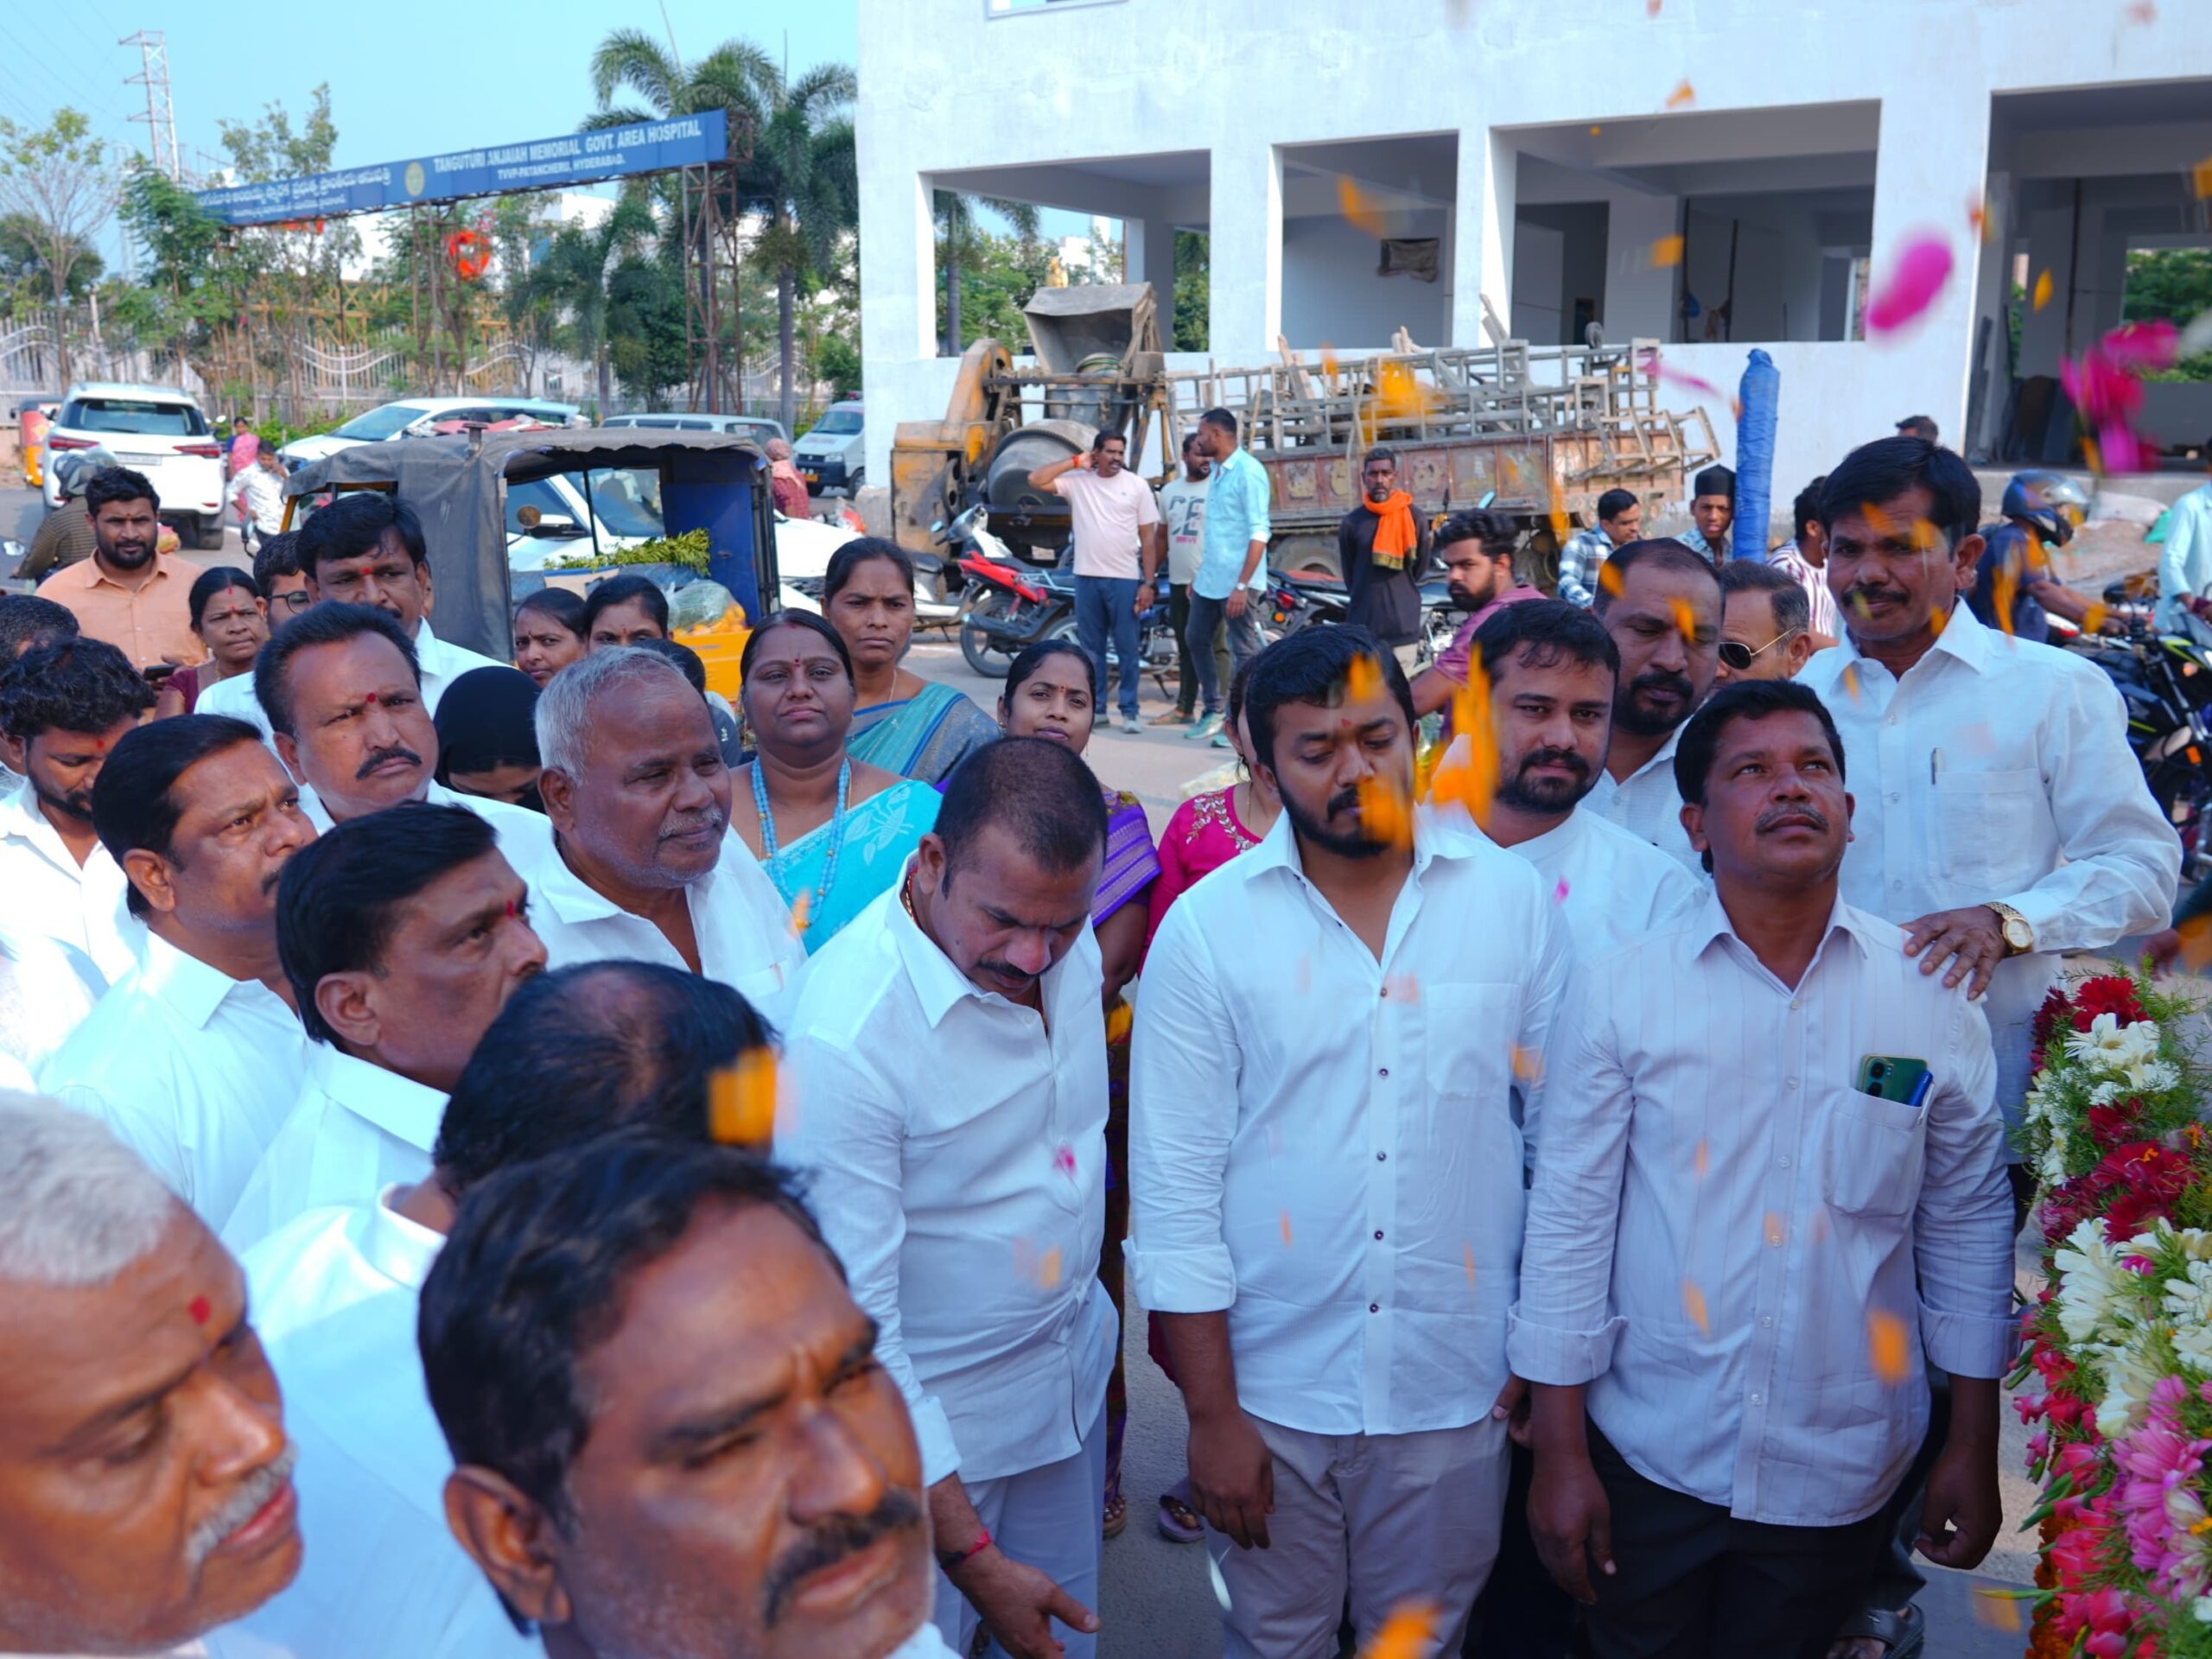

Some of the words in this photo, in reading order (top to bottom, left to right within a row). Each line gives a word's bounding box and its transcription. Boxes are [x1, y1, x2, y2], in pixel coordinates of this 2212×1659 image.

[434, 151, 486, 173] TANGUTURI
[486, 145, 528, 166] ANJAIAH
[530, 138, 581, 161] MEMORIAL
[585, 132, 614, 153] GOVT.
[617, 128, 645, 149] AREA
[647, 120, 701, 143] HOSPITAL
